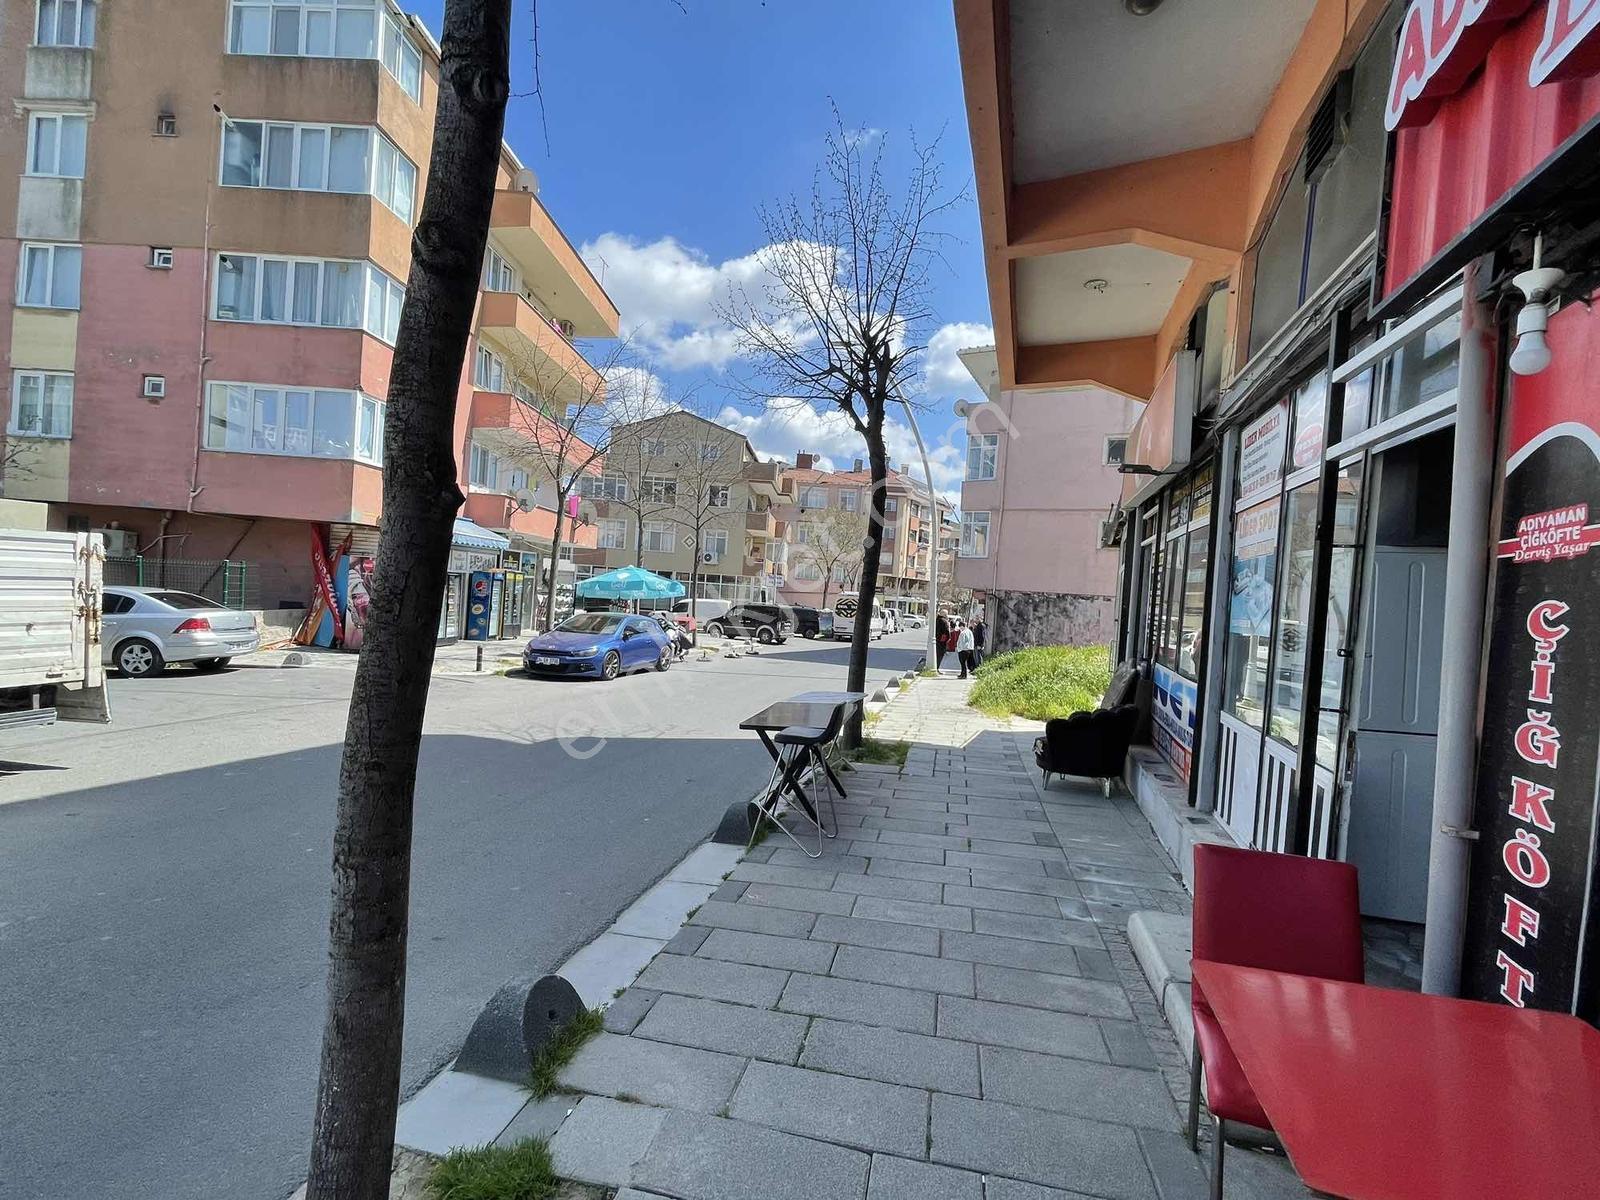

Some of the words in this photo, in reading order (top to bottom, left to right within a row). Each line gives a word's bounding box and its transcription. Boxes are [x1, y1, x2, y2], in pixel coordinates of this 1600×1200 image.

[1519, 507, 1586, 533] ADIYAMAN
[1514, 545, 1552, 560] Derviş
[1554, 542, 1591, 556] Yaşar
[1521, 525, 1581, 551] ÇİĞKÖFTE
